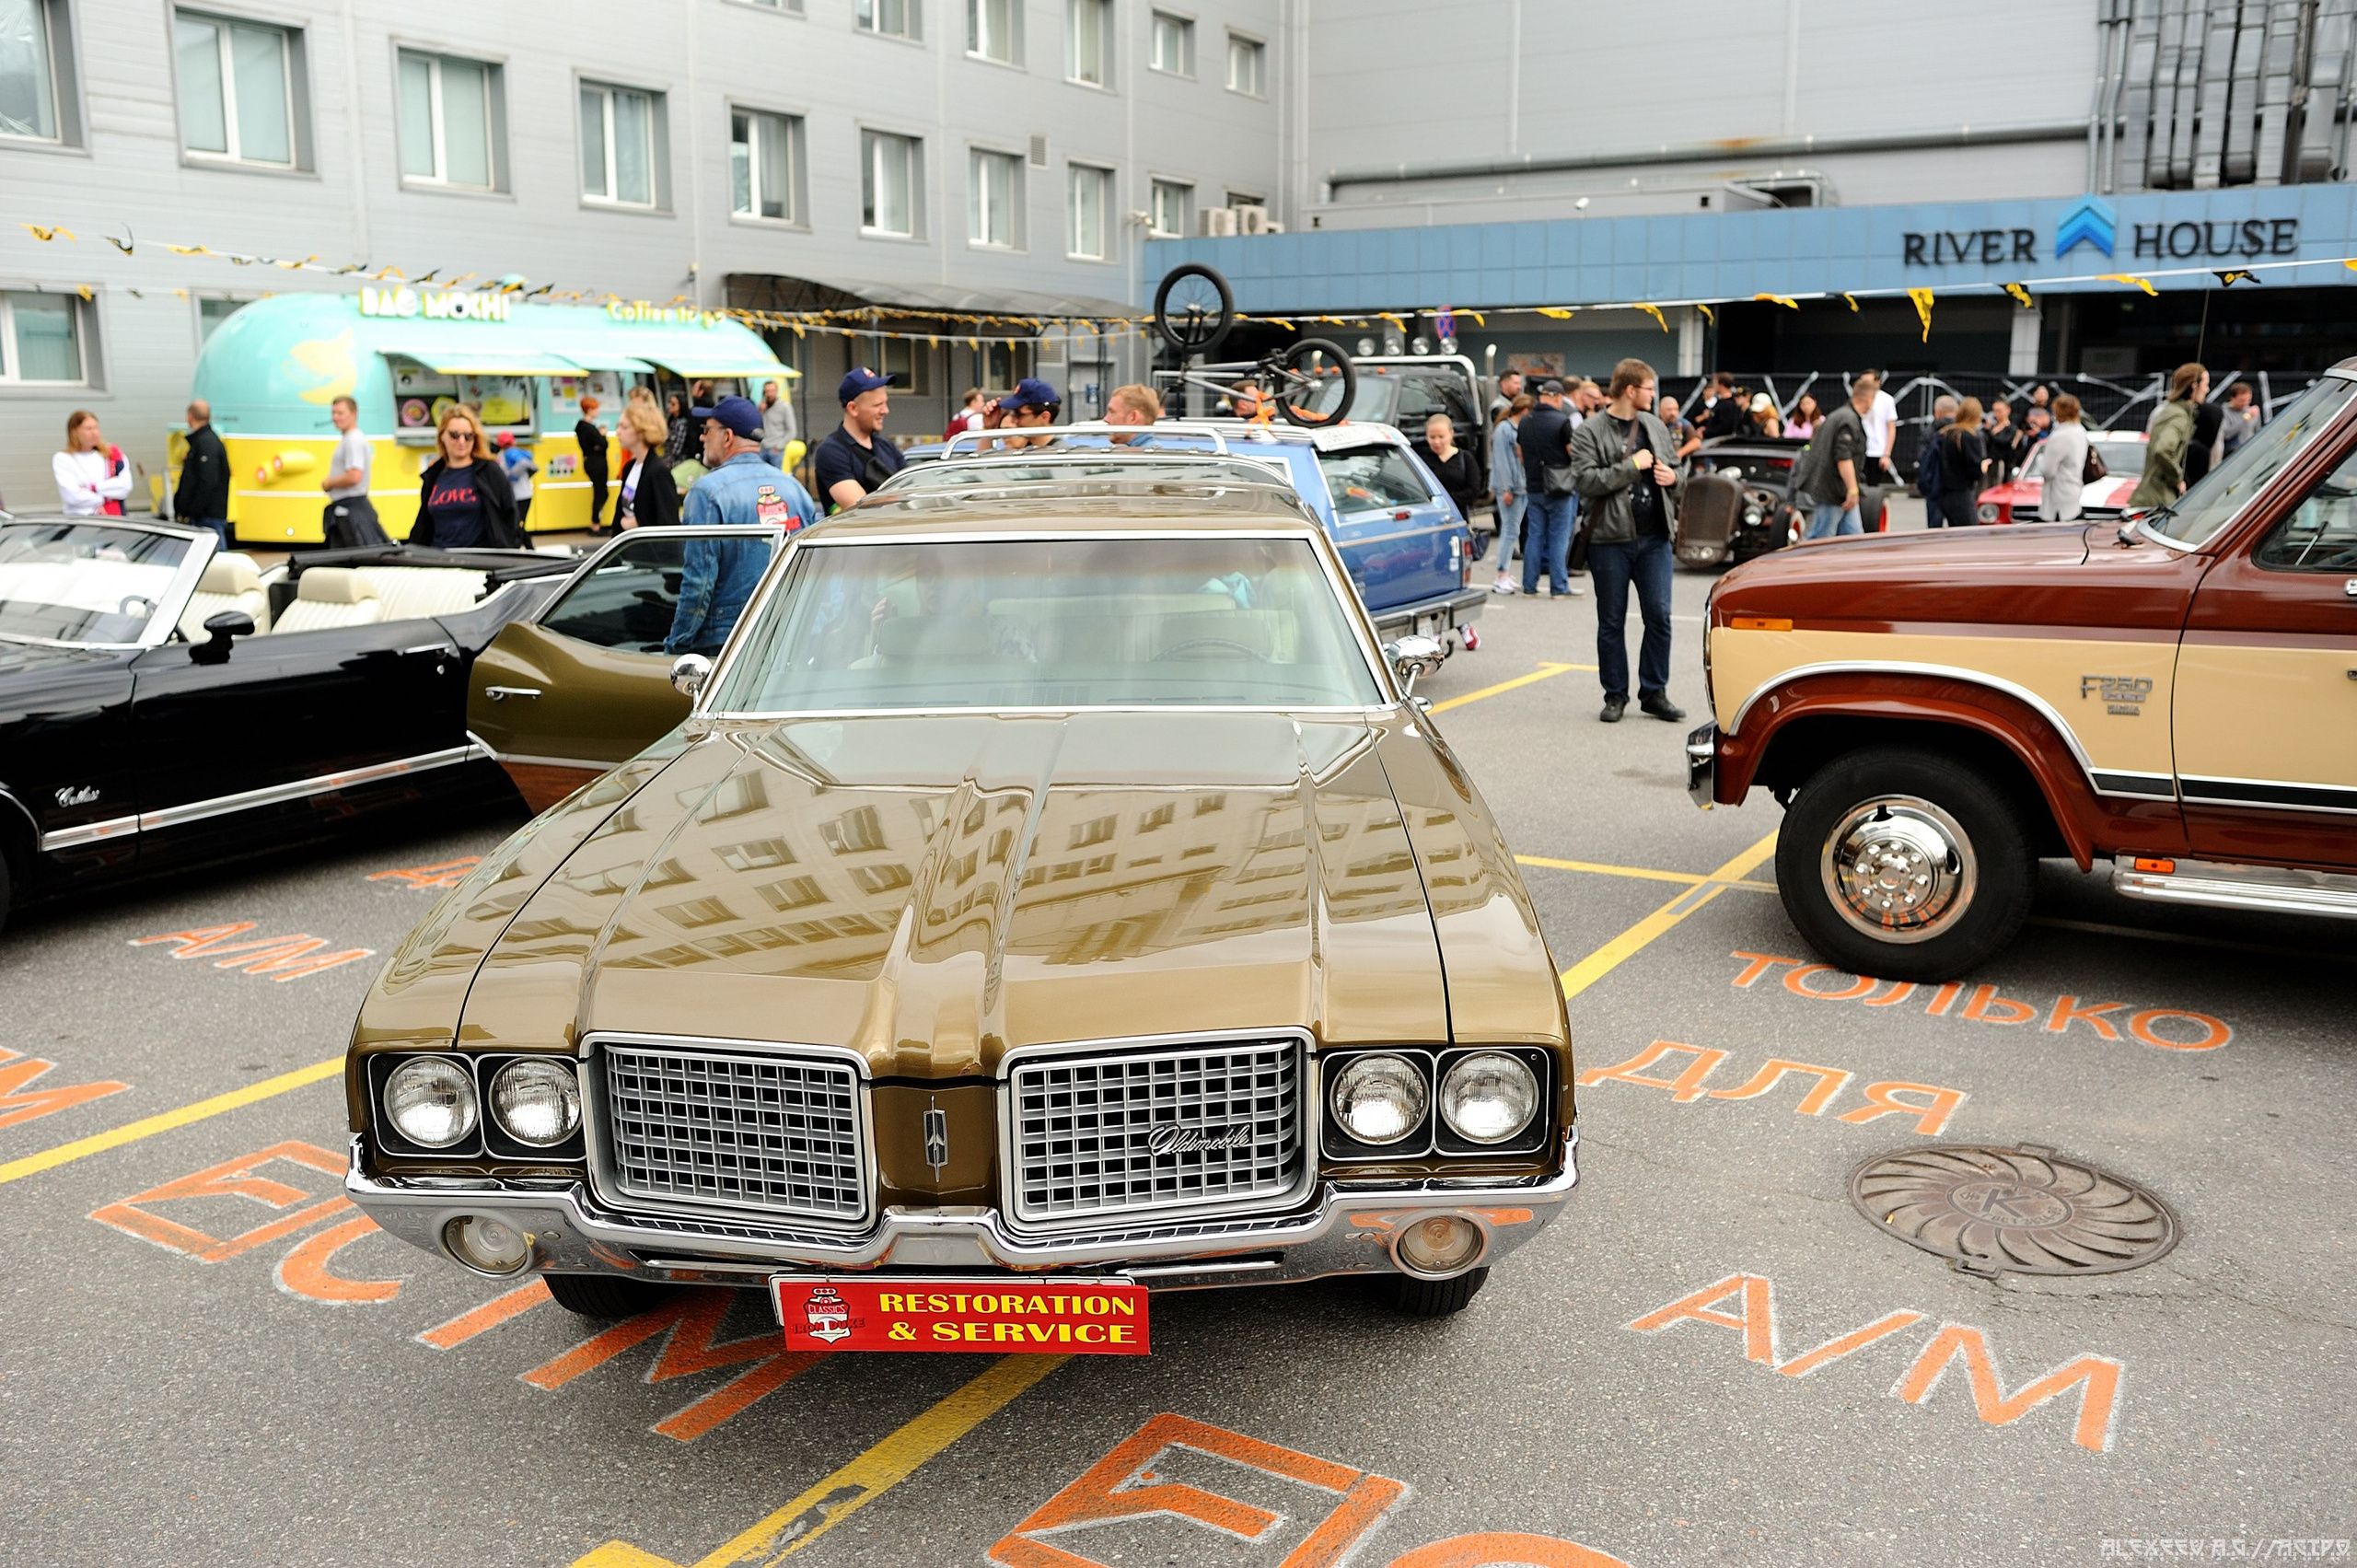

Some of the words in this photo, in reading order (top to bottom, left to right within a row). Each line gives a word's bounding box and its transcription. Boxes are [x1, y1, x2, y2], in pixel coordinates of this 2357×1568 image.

[1902, 229, 2038, 266] RIVER
[2133, 219, 2299, 260] HOUSE
[422, 291, 511, 321] MOCHI
[1729, 950, 2234, 1052] ТОЛЬКО
[1576, 1039, 1968, 1137] ДЛЯ
[1148, 1123, 1250, 1156] Oldsmobile
[808, 1304, 846, 1314] CLASSICS
[879, 1294, 1134, 1316] RESTORATION
[794, 1321, 825, 1334] IRON
[828, 1318, 865, 1331] DUKE
[888, 1321, 917, 1341] &
[932, 1322, 1137, 1343] SERVICE
[1623, 1272, 2125, 1453] А/М
